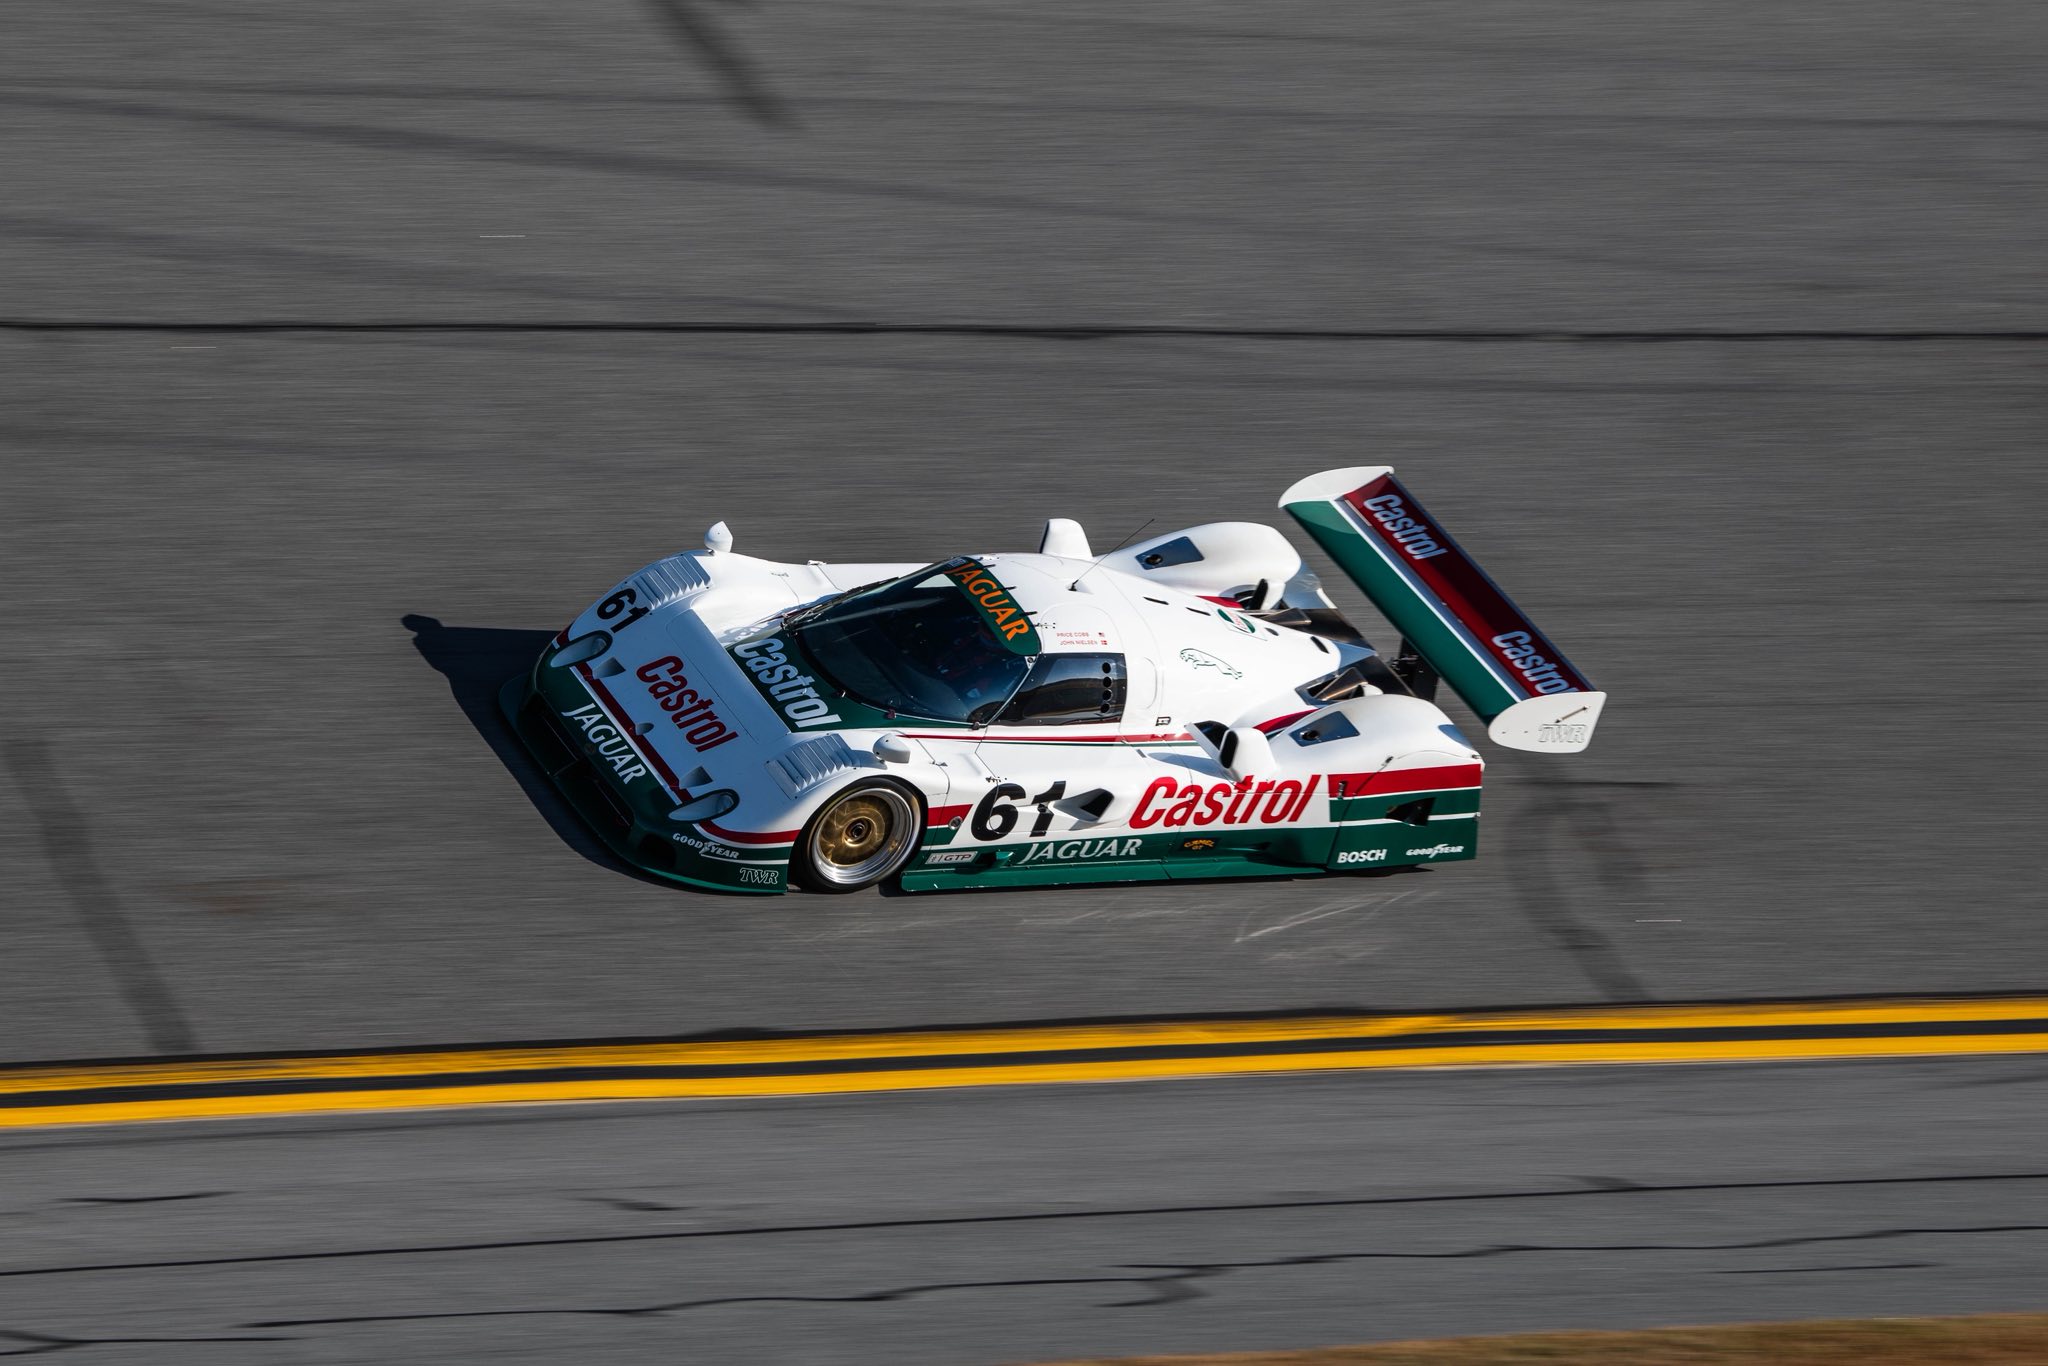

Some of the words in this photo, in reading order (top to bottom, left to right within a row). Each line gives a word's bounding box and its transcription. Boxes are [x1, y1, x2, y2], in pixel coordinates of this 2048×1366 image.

[1363, 494, 1448, 560] Castrol
[597, 588, 649, 633] 61
[943, 562, 1029, 642] JAGUAR
[733, 638, 842, 728] Castrol
[1491, 630, 1580, 694] Castro
[636, 655, 739, 753] Castrol
[1537, 723, 1588, 743] TWR
[562, 703, 647, 784] JAGUAR
[971, 780, 1066, 841] 61
[1129, 774, 1322, 829] Castrol
[740, 867, 779, 885] TWR
[944, 853, 972, 862] GTP
[1018, 838, 1143, 865] JAGUAR
[1337, 848, 1388, 864] BOSCH
